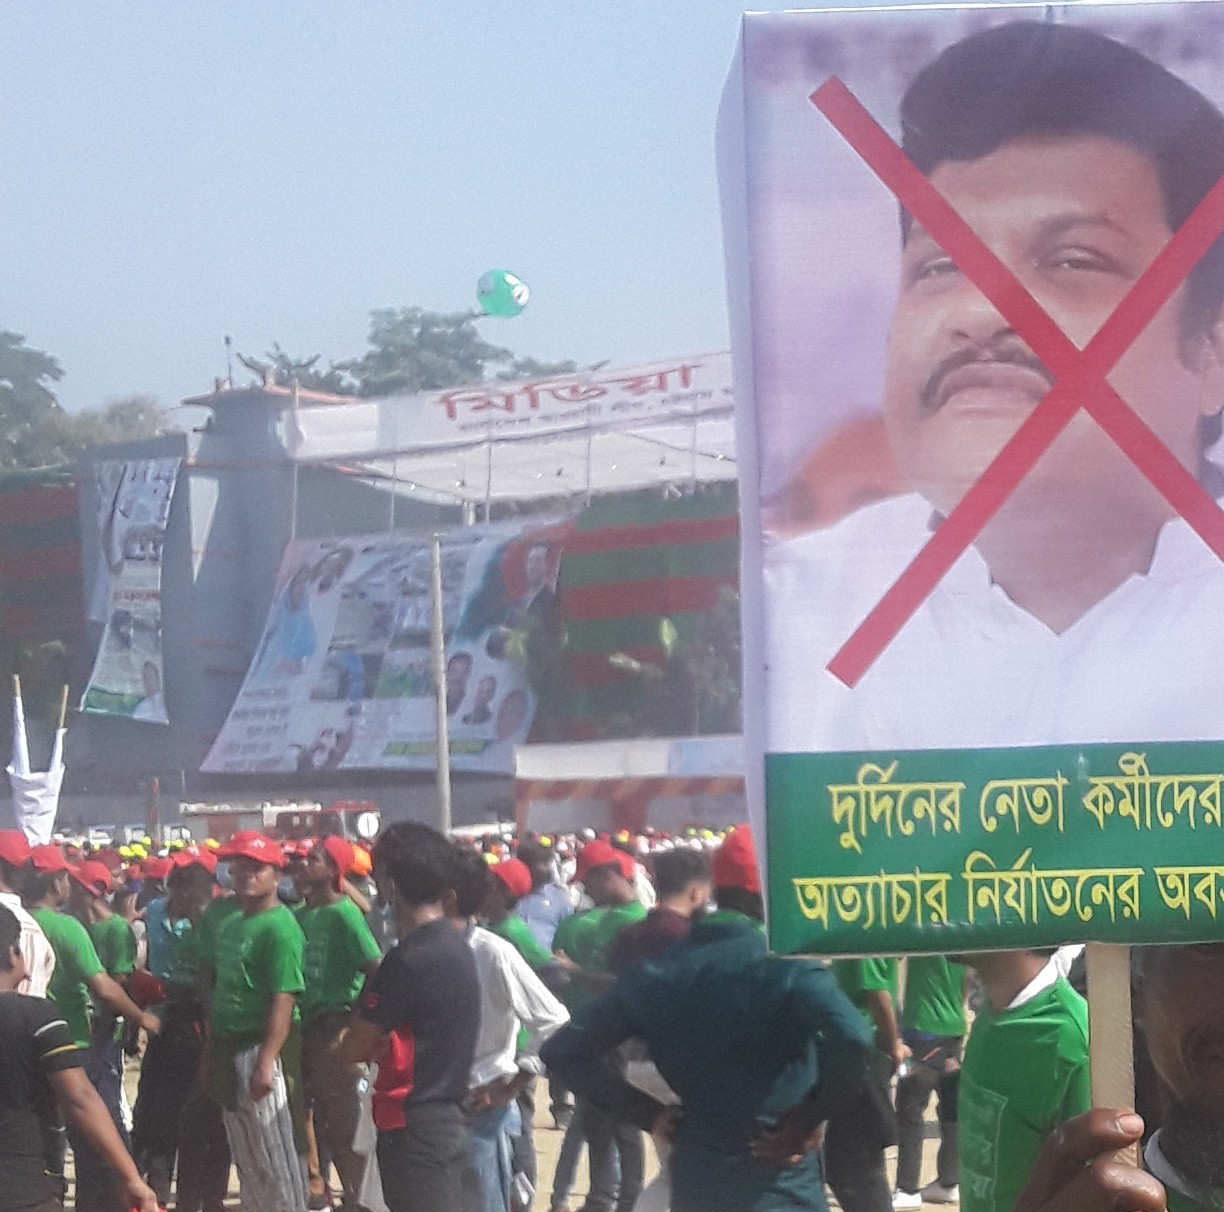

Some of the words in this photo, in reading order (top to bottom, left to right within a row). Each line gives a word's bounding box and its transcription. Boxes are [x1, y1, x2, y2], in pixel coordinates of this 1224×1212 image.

[827, 761, 967, 855] দুর্দিনের
[978, 769, 1069, 834] নেতা
[792, 866, 953, 931] অত্যাচার
[962, 847, 1145, 926] নির্যাতনের
